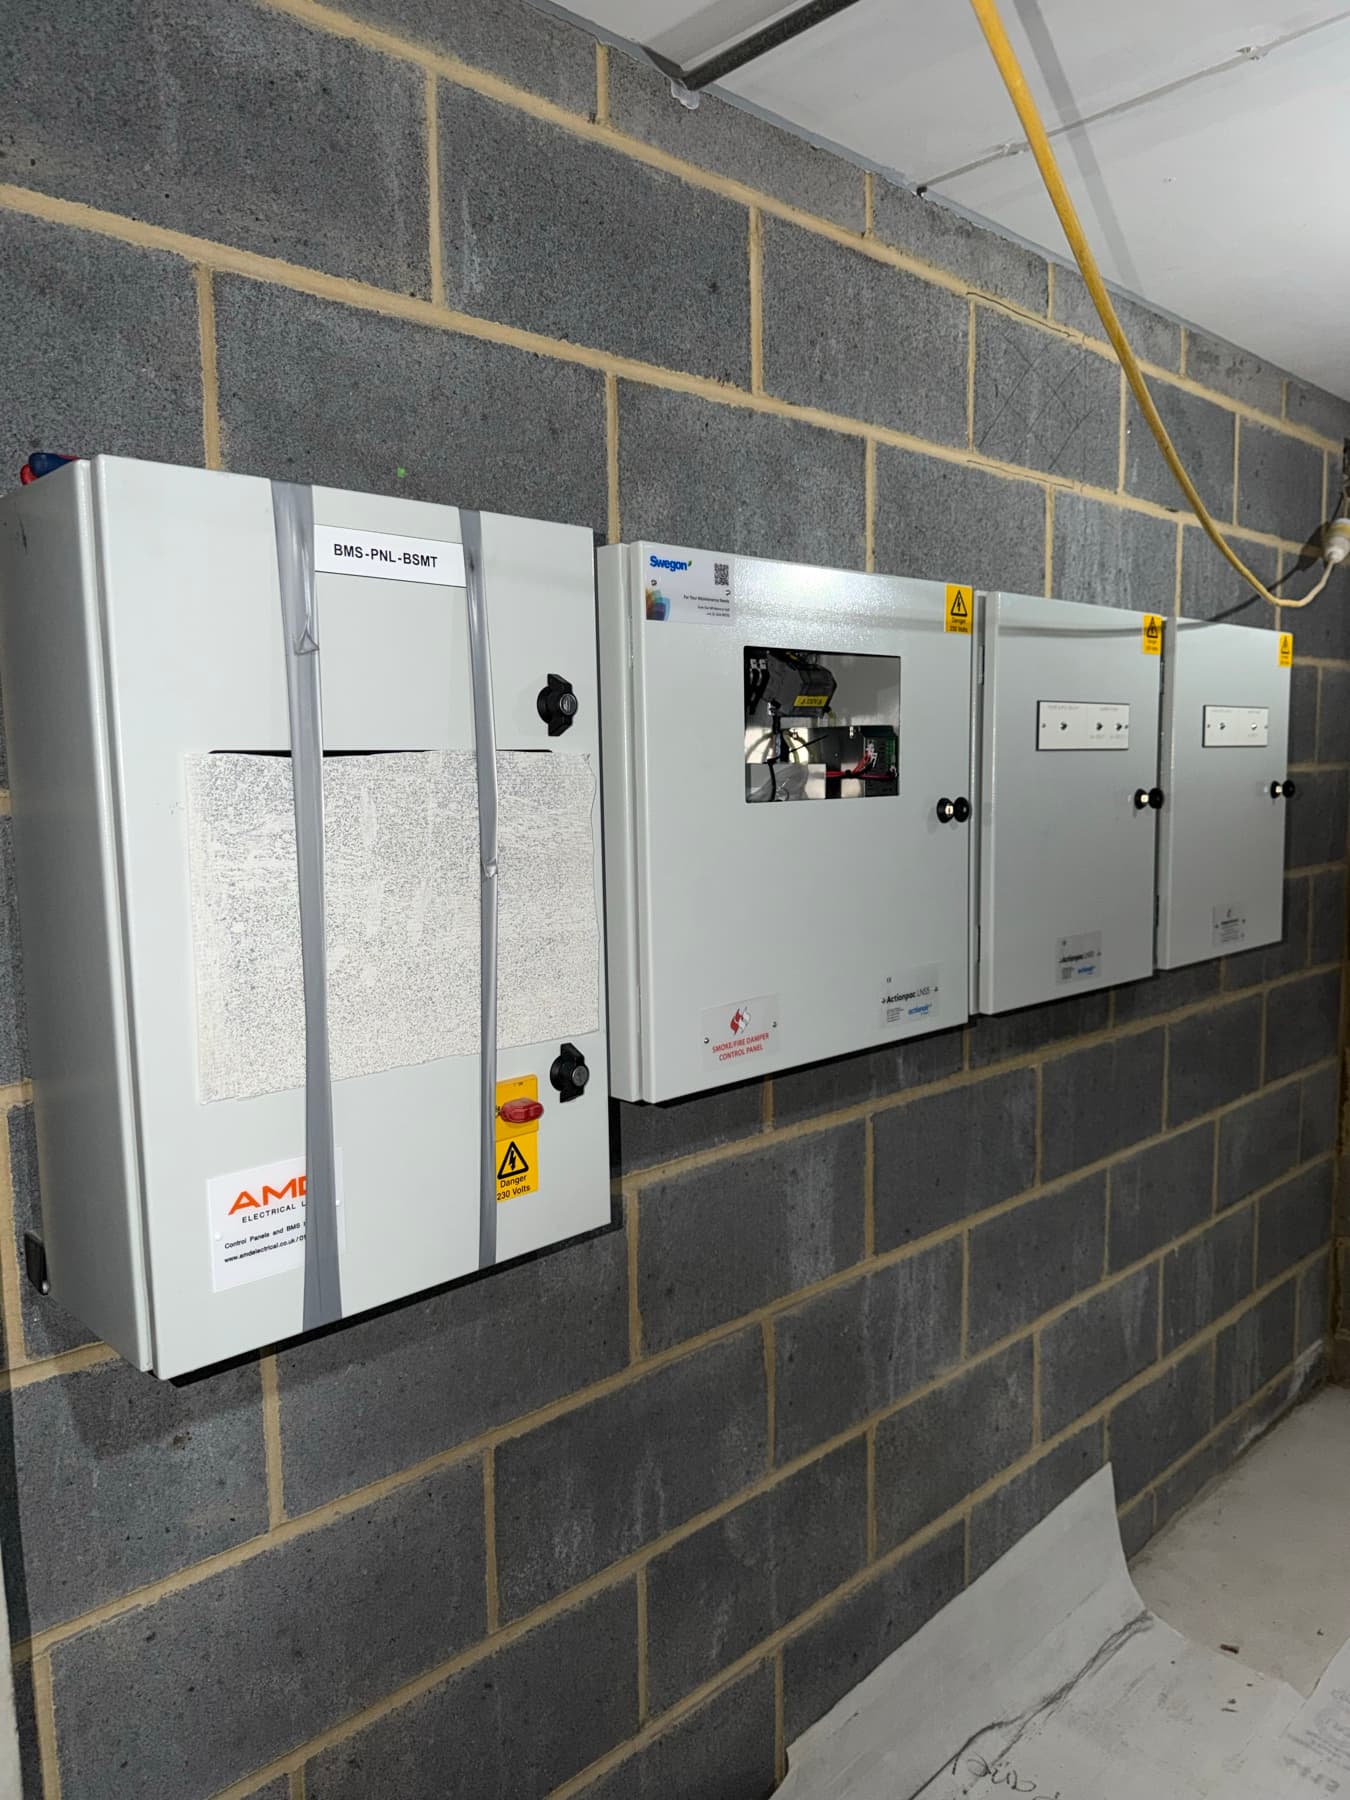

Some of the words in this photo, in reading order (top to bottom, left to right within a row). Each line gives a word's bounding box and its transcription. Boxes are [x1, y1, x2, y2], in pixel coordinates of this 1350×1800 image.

[333, 543, 438, 568] BMS-PNL-BSMT
[649, 555, 688, 572] Swegon
[747, 1032, 769, 1044] DAMPER
[719, 1048, 745, 1061] CONTROL
[746, 1044, 763, 1055] PANEL
[500, 1175, 527, 1189] Danger
[496, 1189, 511, 1201] 230
[512, 1184, 531, 1197] Volts
[241, 1203, 297, 1224] ELECTRICAL
[224, 1238, 247, 1250] Control
[249, 1231, 271, 1243] Panels
[272, 1227, 284, 1236] and
[286, 1222, 301, 1232] BMS
